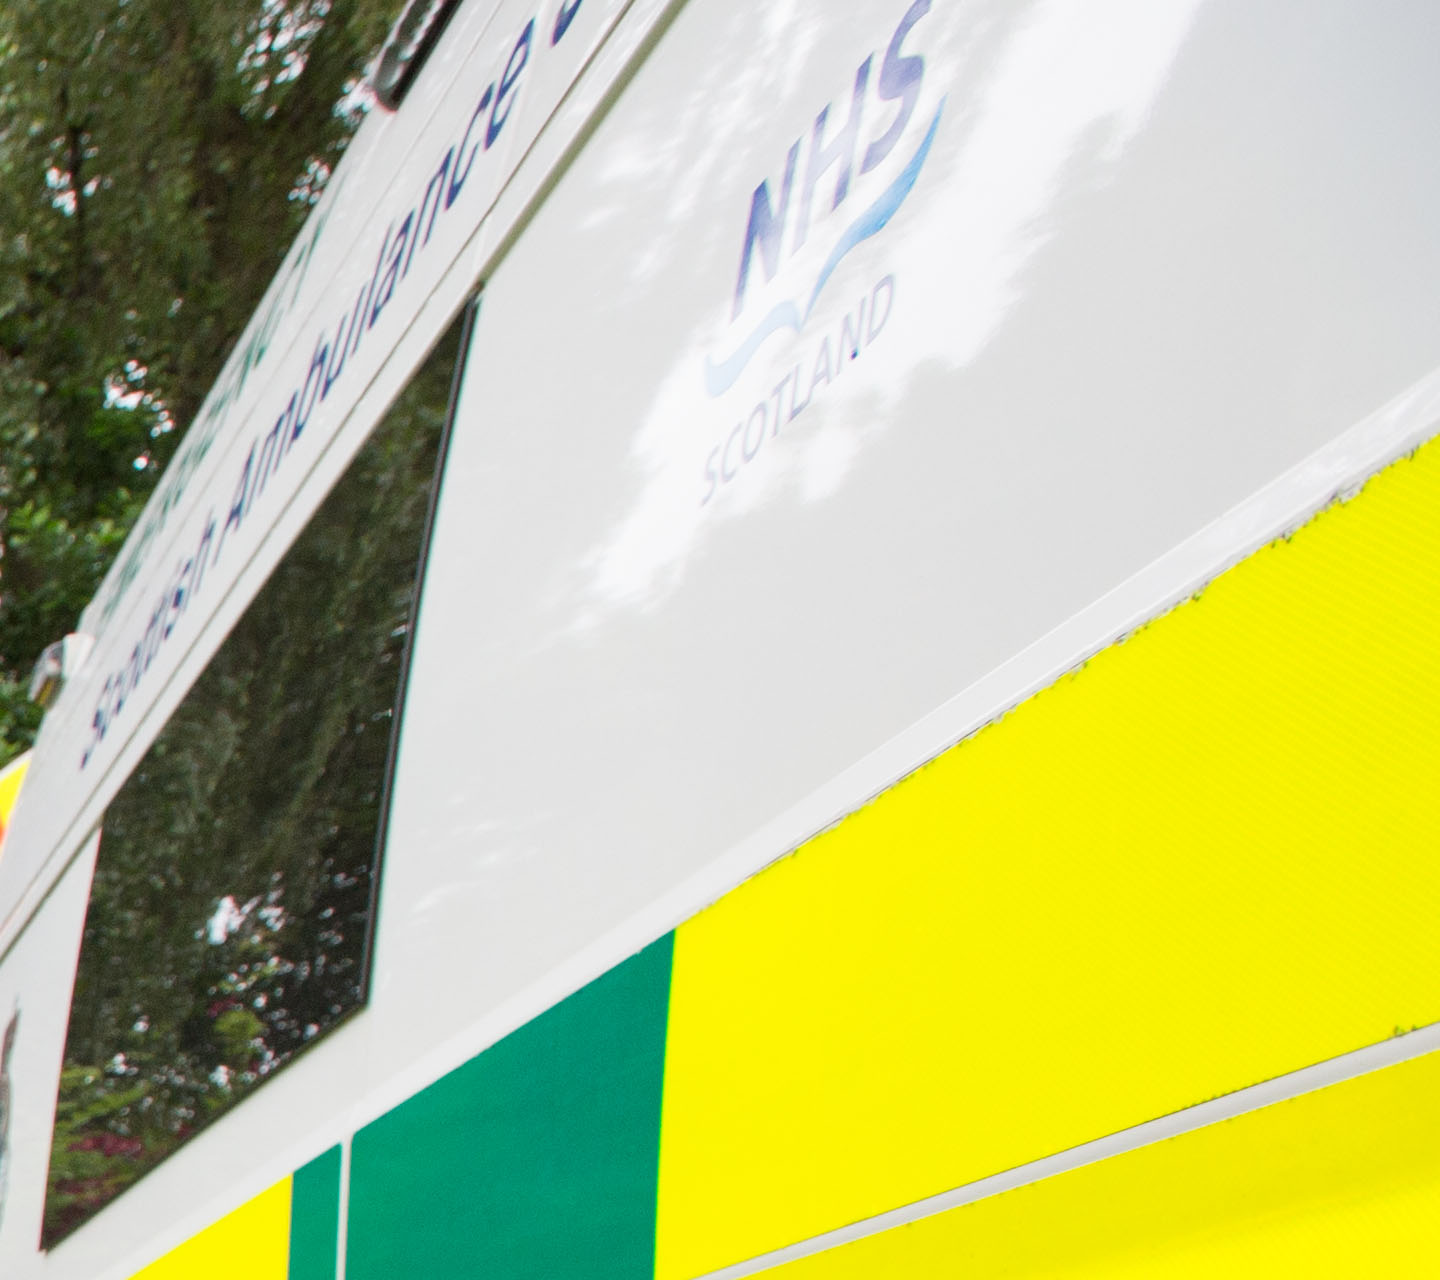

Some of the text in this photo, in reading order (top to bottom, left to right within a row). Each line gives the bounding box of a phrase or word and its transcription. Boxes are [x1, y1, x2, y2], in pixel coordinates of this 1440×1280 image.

[212, 16, 535, 568] Ambulance
[730, 0, 932, 325] NHS
[700, 273, 895, 508] SCOTLAND
